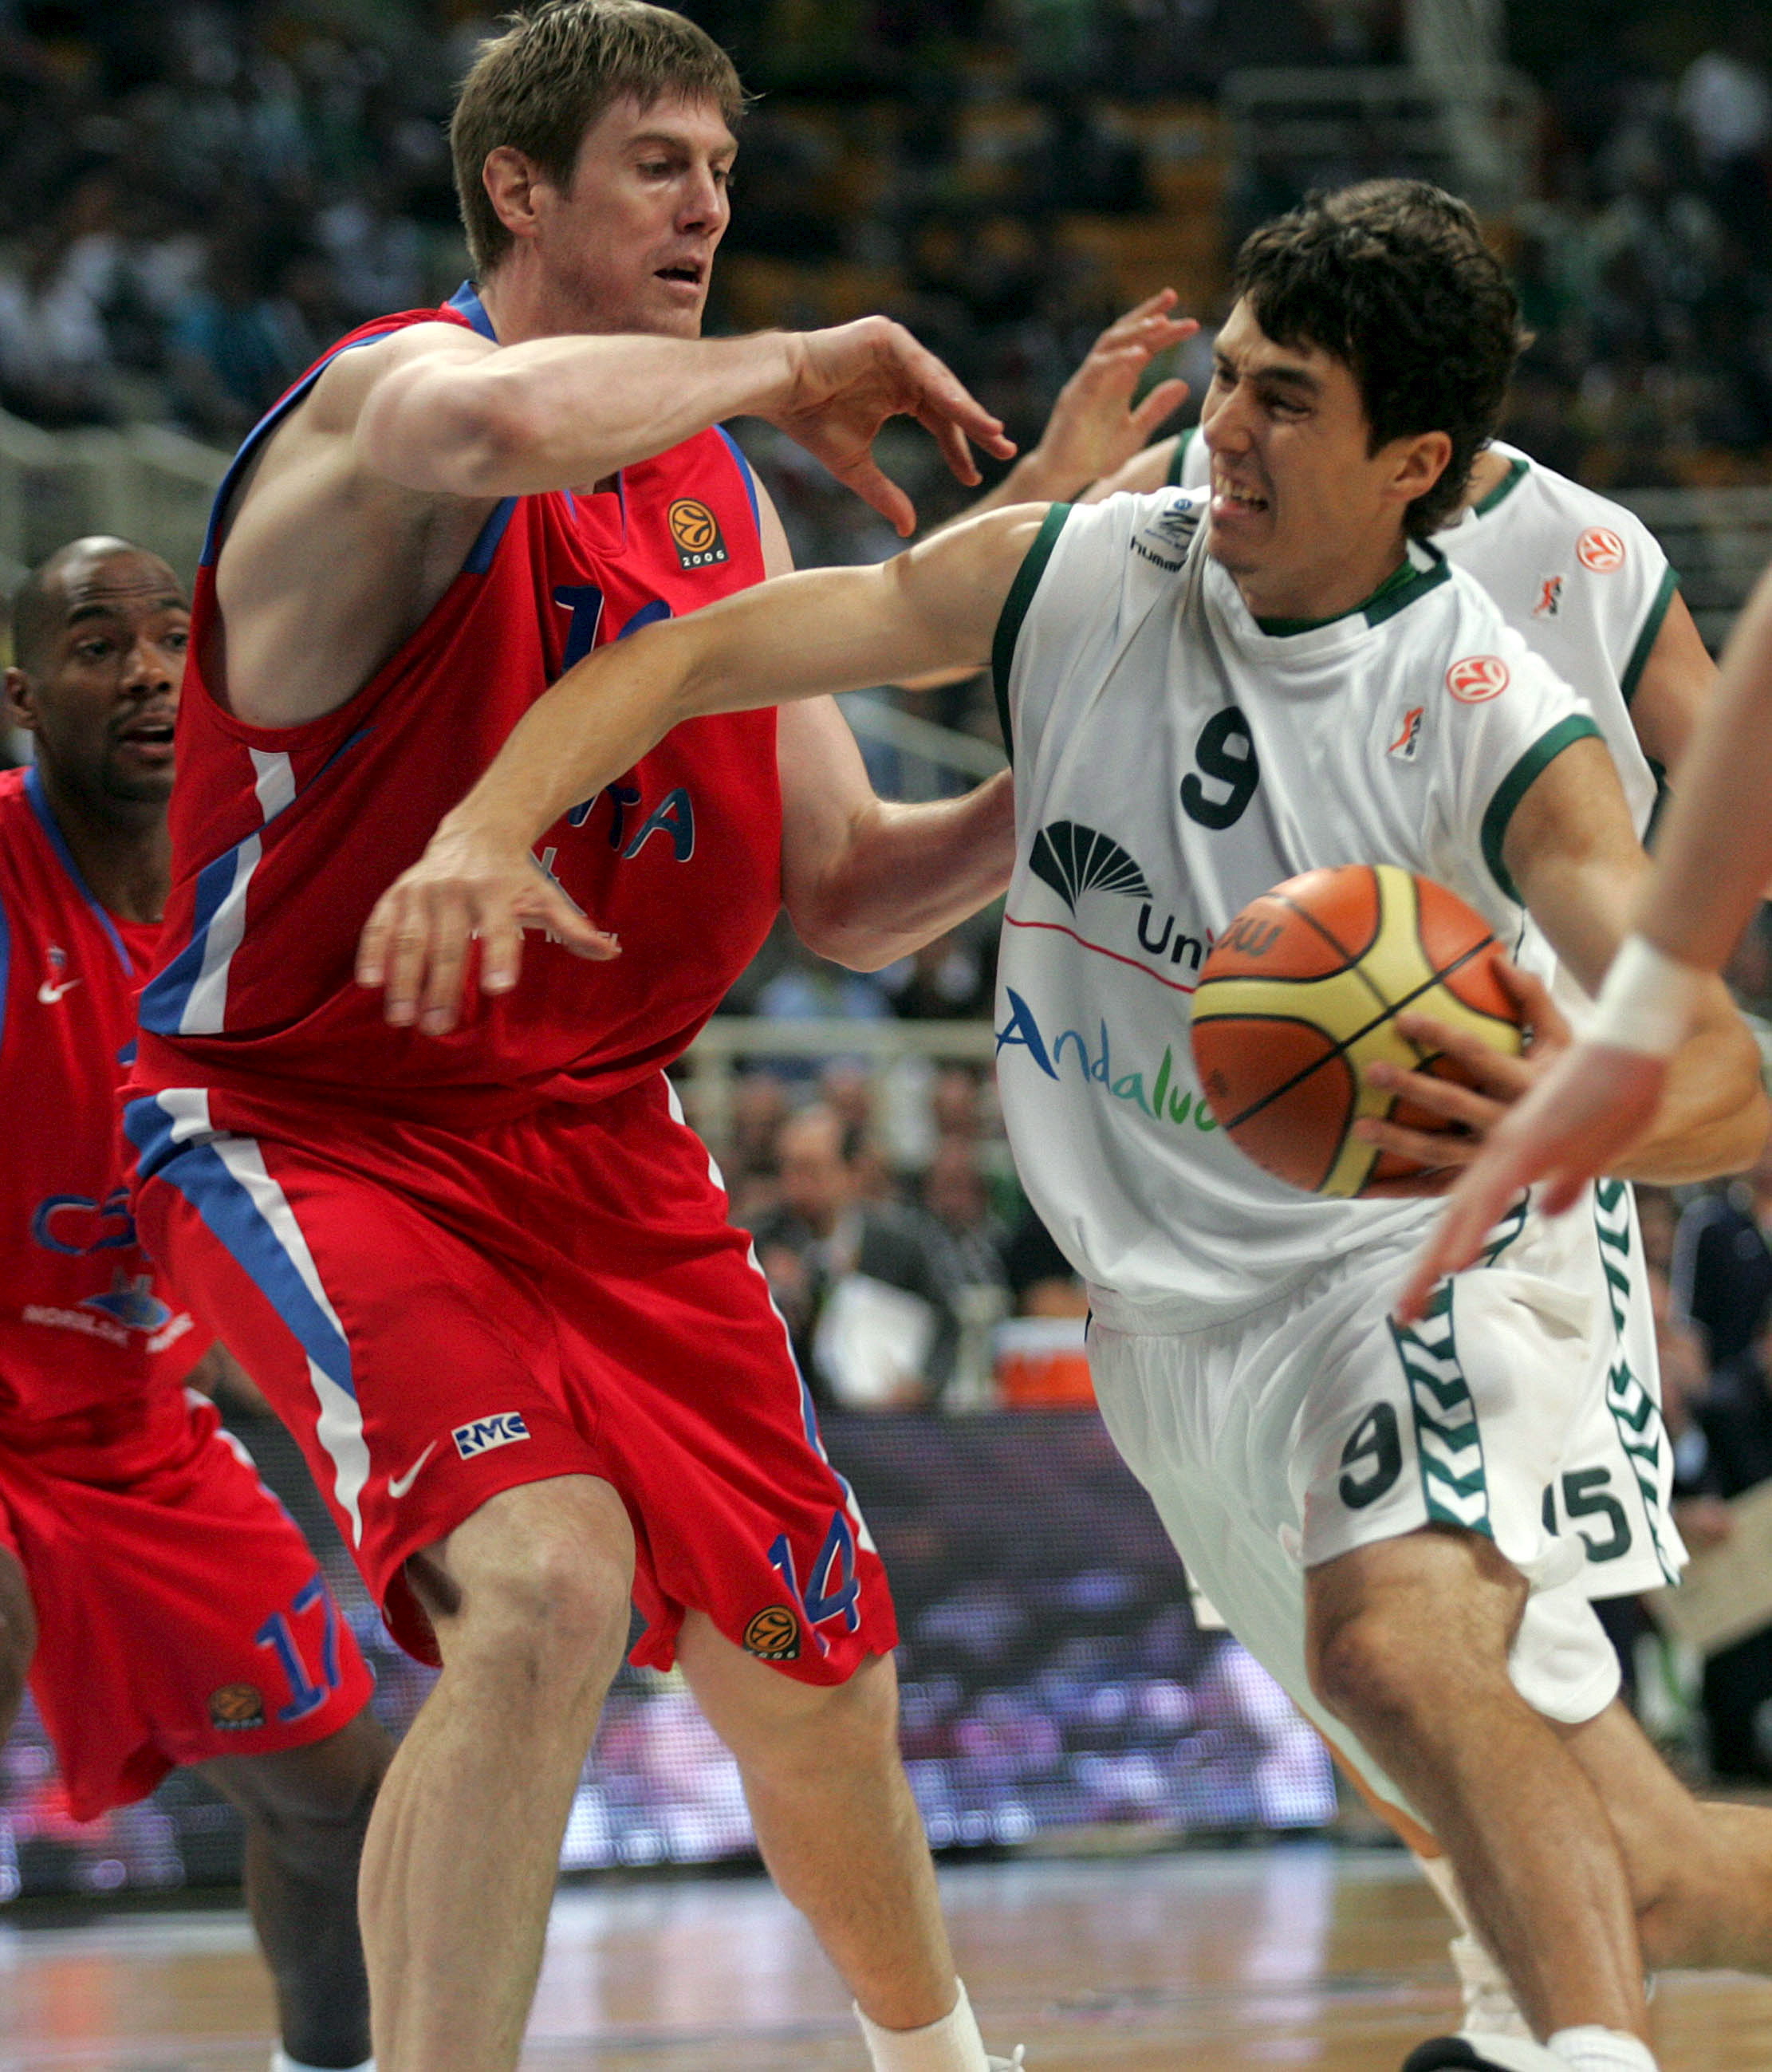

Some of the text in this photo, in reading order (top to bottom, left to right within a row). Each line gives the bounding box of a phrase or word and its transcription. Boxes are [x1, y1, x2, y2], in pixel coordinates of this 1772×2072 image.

[682, 550, 725, 566] 2006
[1180, 706, 1260, 831] 9
[1338, 1401, 1403, 1510] 9
[1542, 1466, 1632, 1563] 15
[766, 1510, 861, 1659] 14
[255, 1570, 343, 1724] 17
